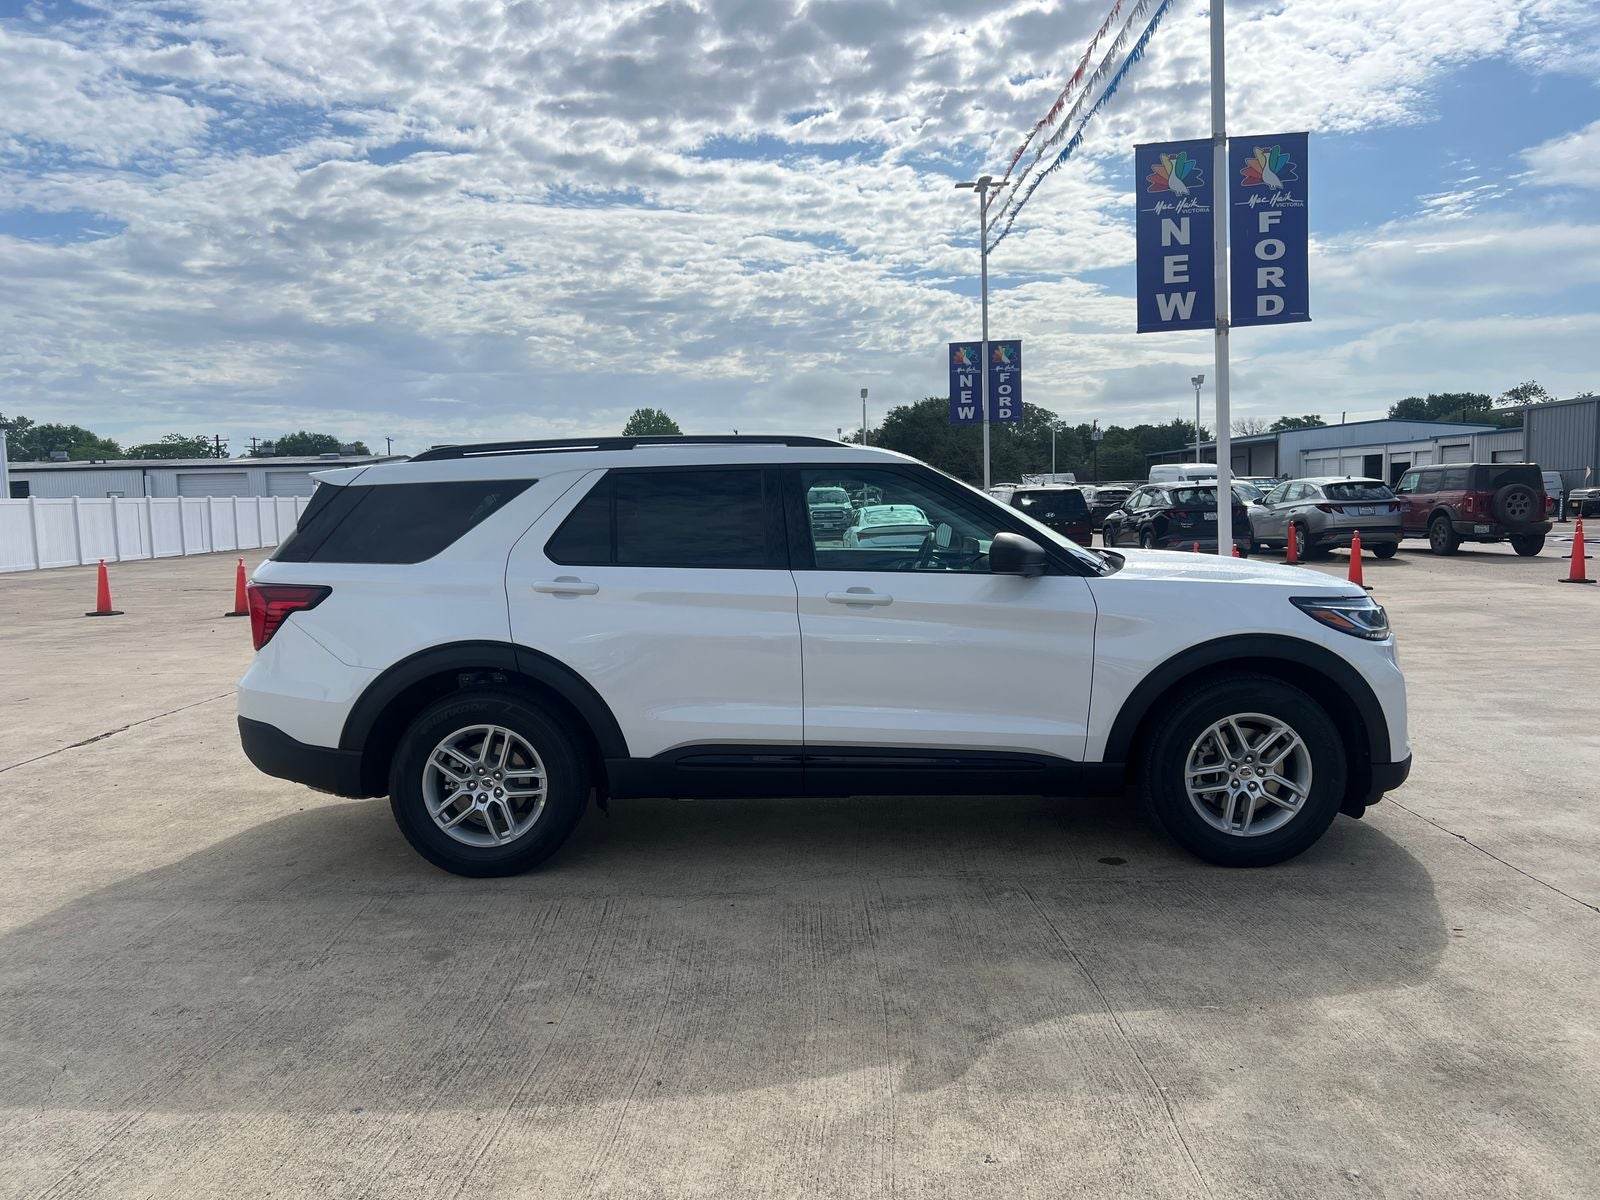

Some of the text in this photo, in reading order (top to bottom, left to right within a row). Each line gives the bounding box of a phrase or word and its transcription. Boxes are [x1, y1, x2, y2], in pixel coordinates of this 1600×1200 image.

[1153, 197, 1200, 215] Mac Haik
[1247, 191, 1294, 208] Mac Haik
[1155, 217, 1197, 321] NEW
[1254, 210, 1286, 317] FORD
[958, 375, 975, 419] NEW
[998, 373, 1012, 418] FORD
